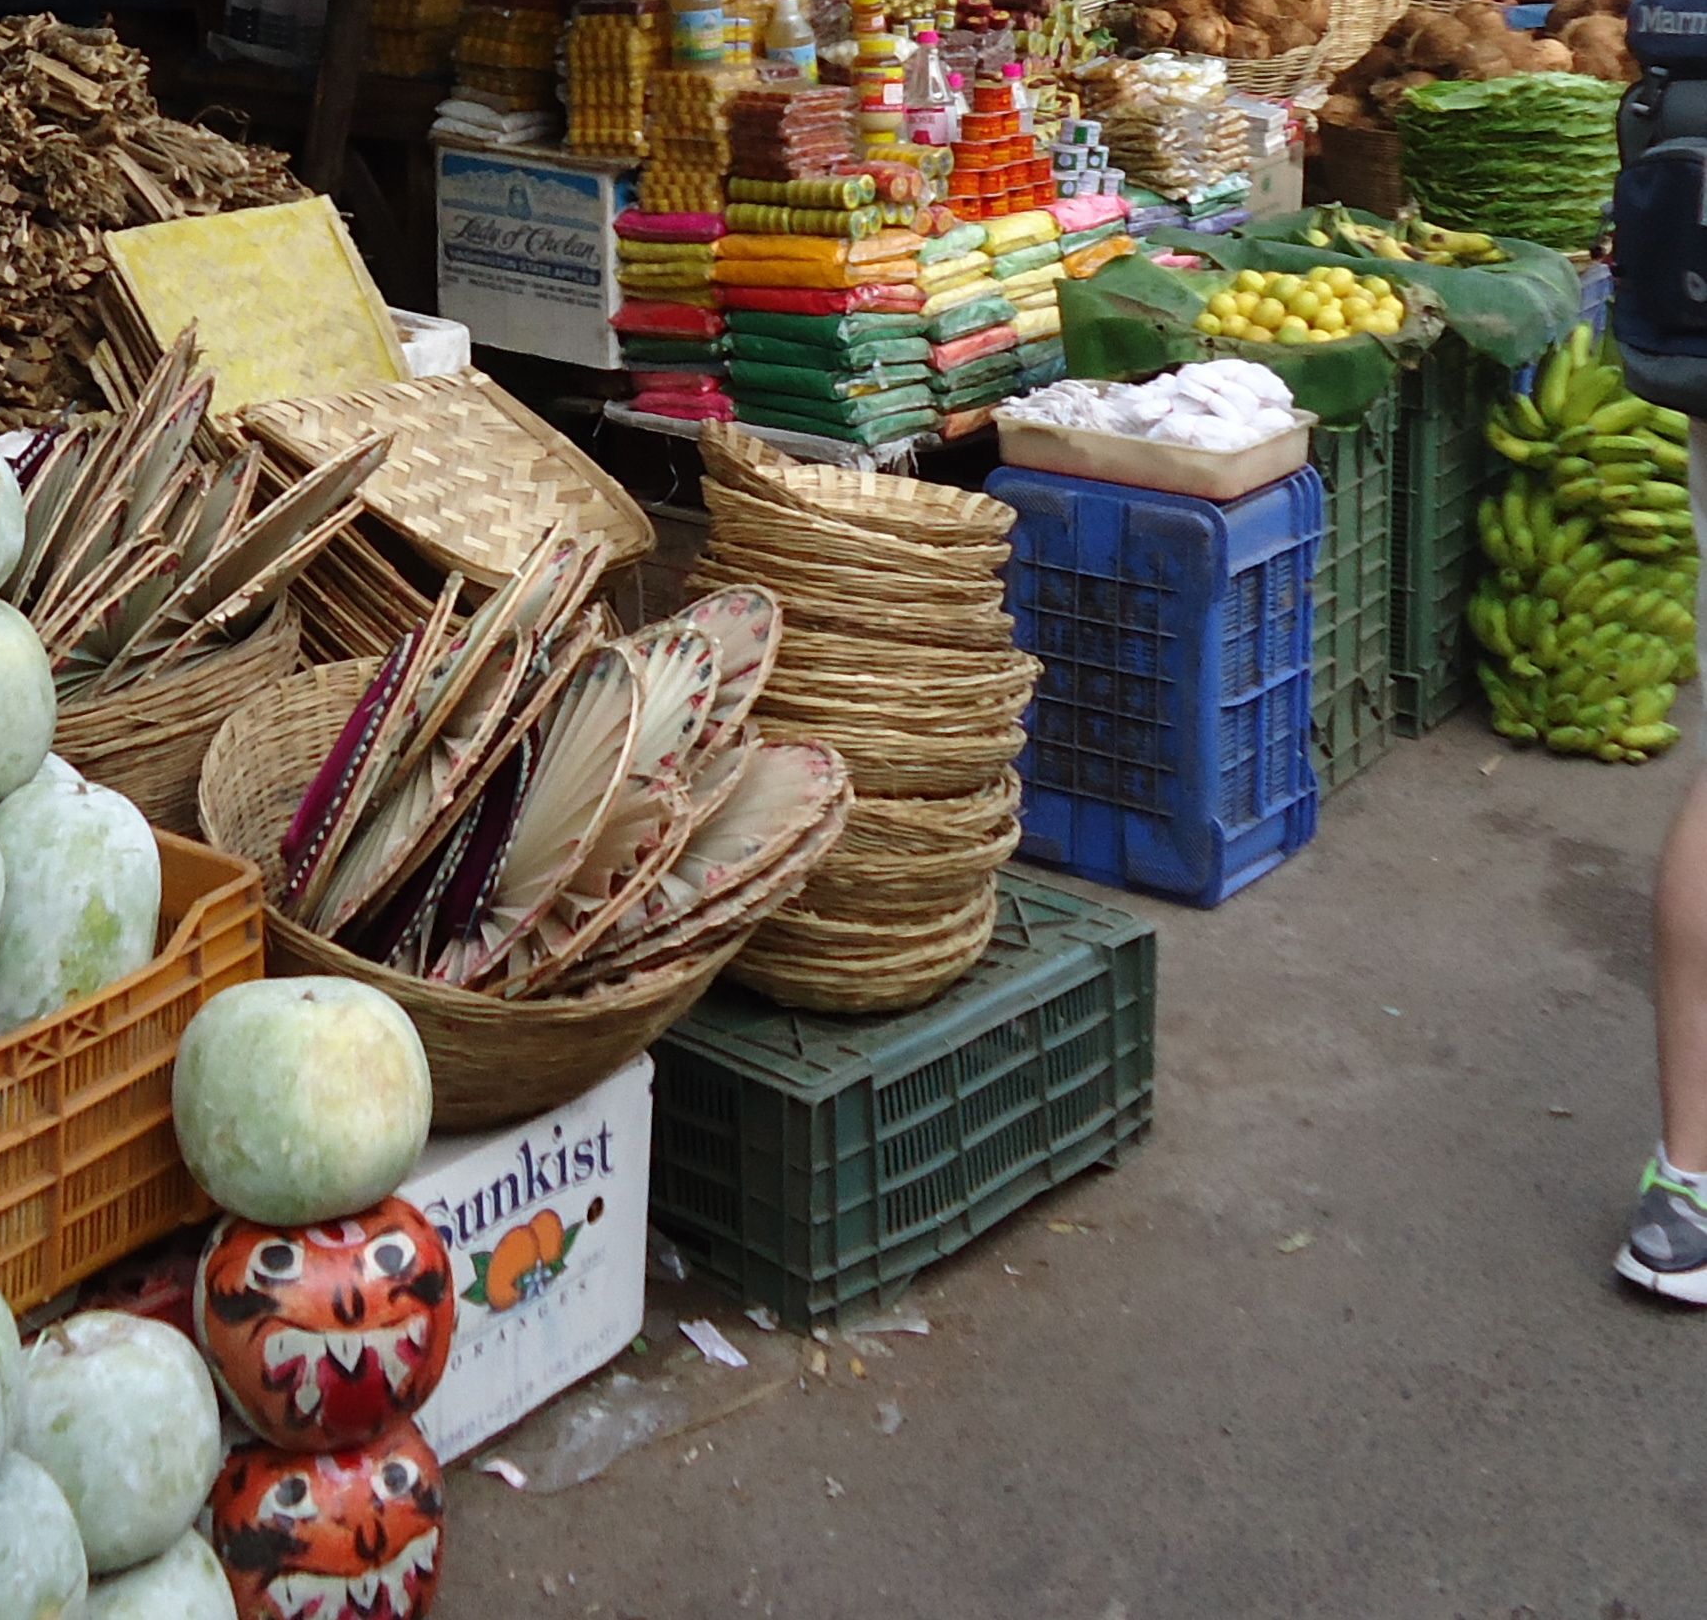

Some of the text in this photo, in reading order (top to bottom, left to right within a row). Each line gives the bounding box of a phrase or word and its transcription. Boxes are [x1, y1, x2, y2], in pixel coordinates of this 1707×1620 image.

[498, 225, 532, 250] of
[524, 227, 601, 266] Chelan
[424, 1119, 614, 1250] Sunkist
